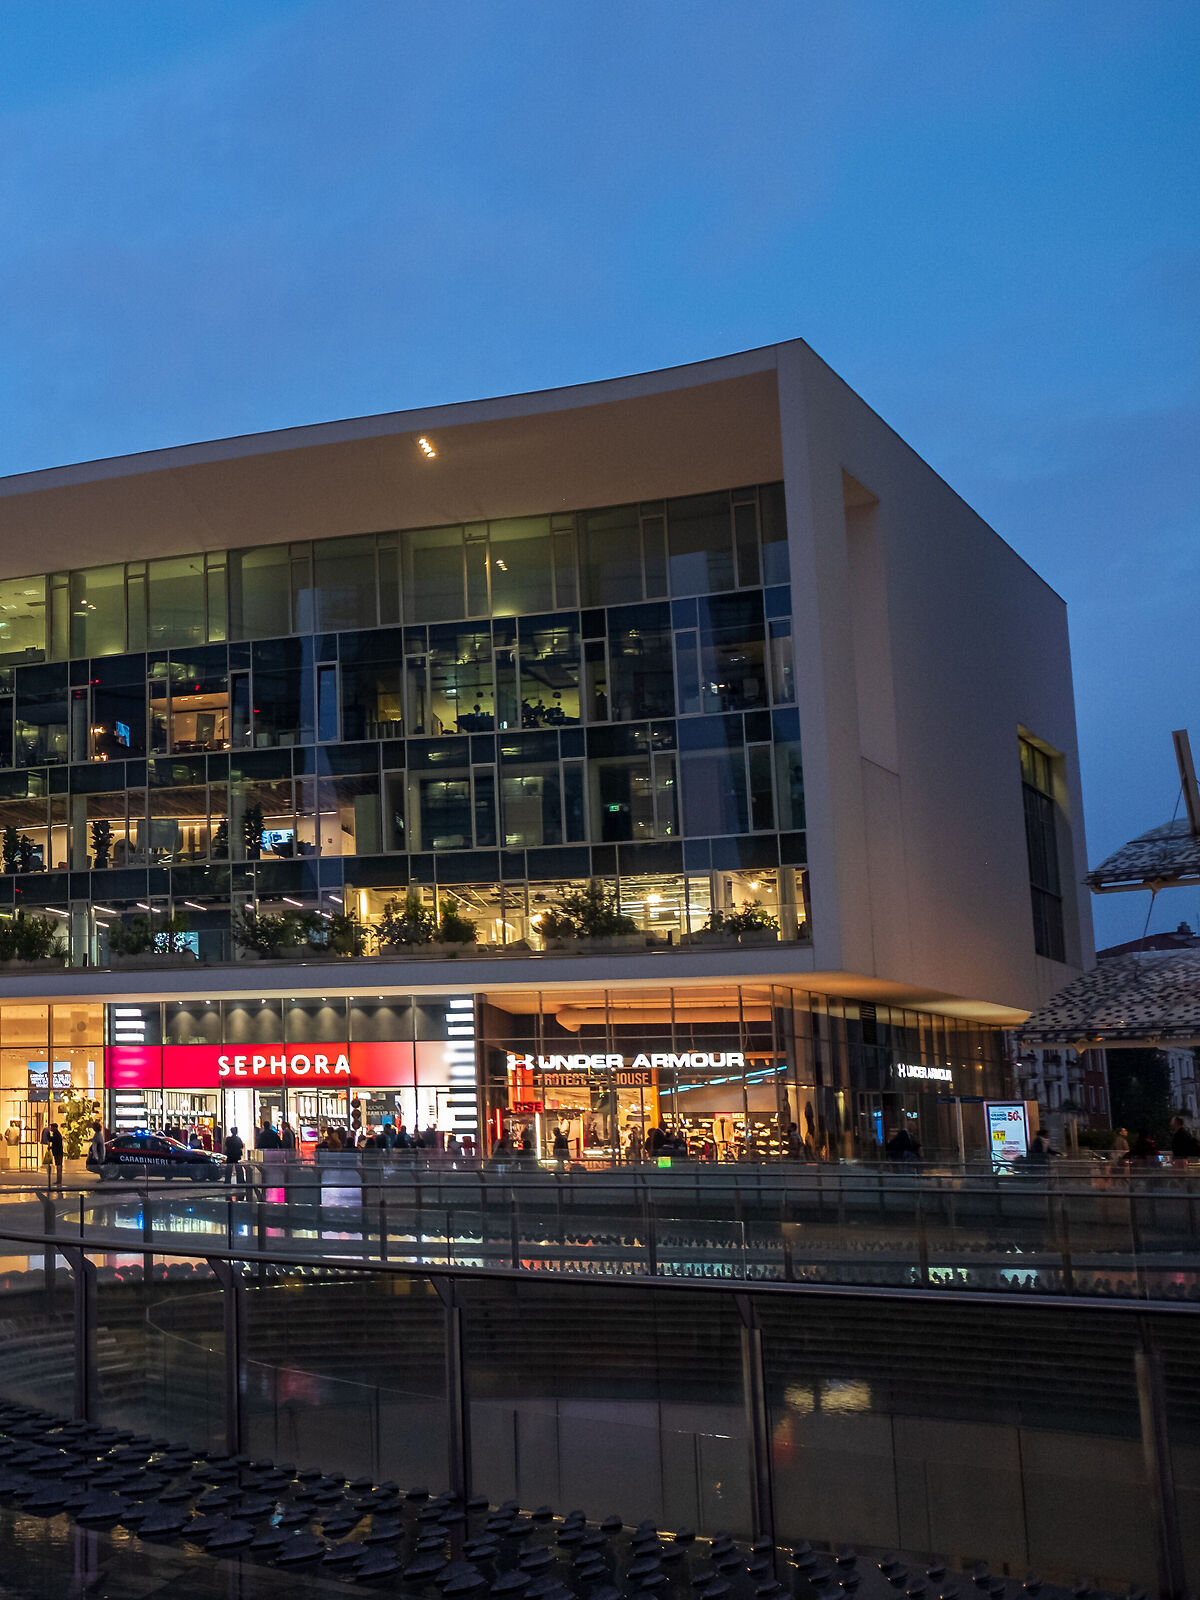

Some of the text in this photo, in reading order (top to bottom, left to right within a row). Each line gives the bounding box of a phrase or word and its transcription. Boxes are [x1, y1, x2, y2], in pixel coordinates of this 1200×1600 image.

[218, 1054, 351, 1076] SEPHORA
[538, 1053, 744, 1070] UNDER ARMOUR
[120, 1155, 169, 1165] CARABINIERI
